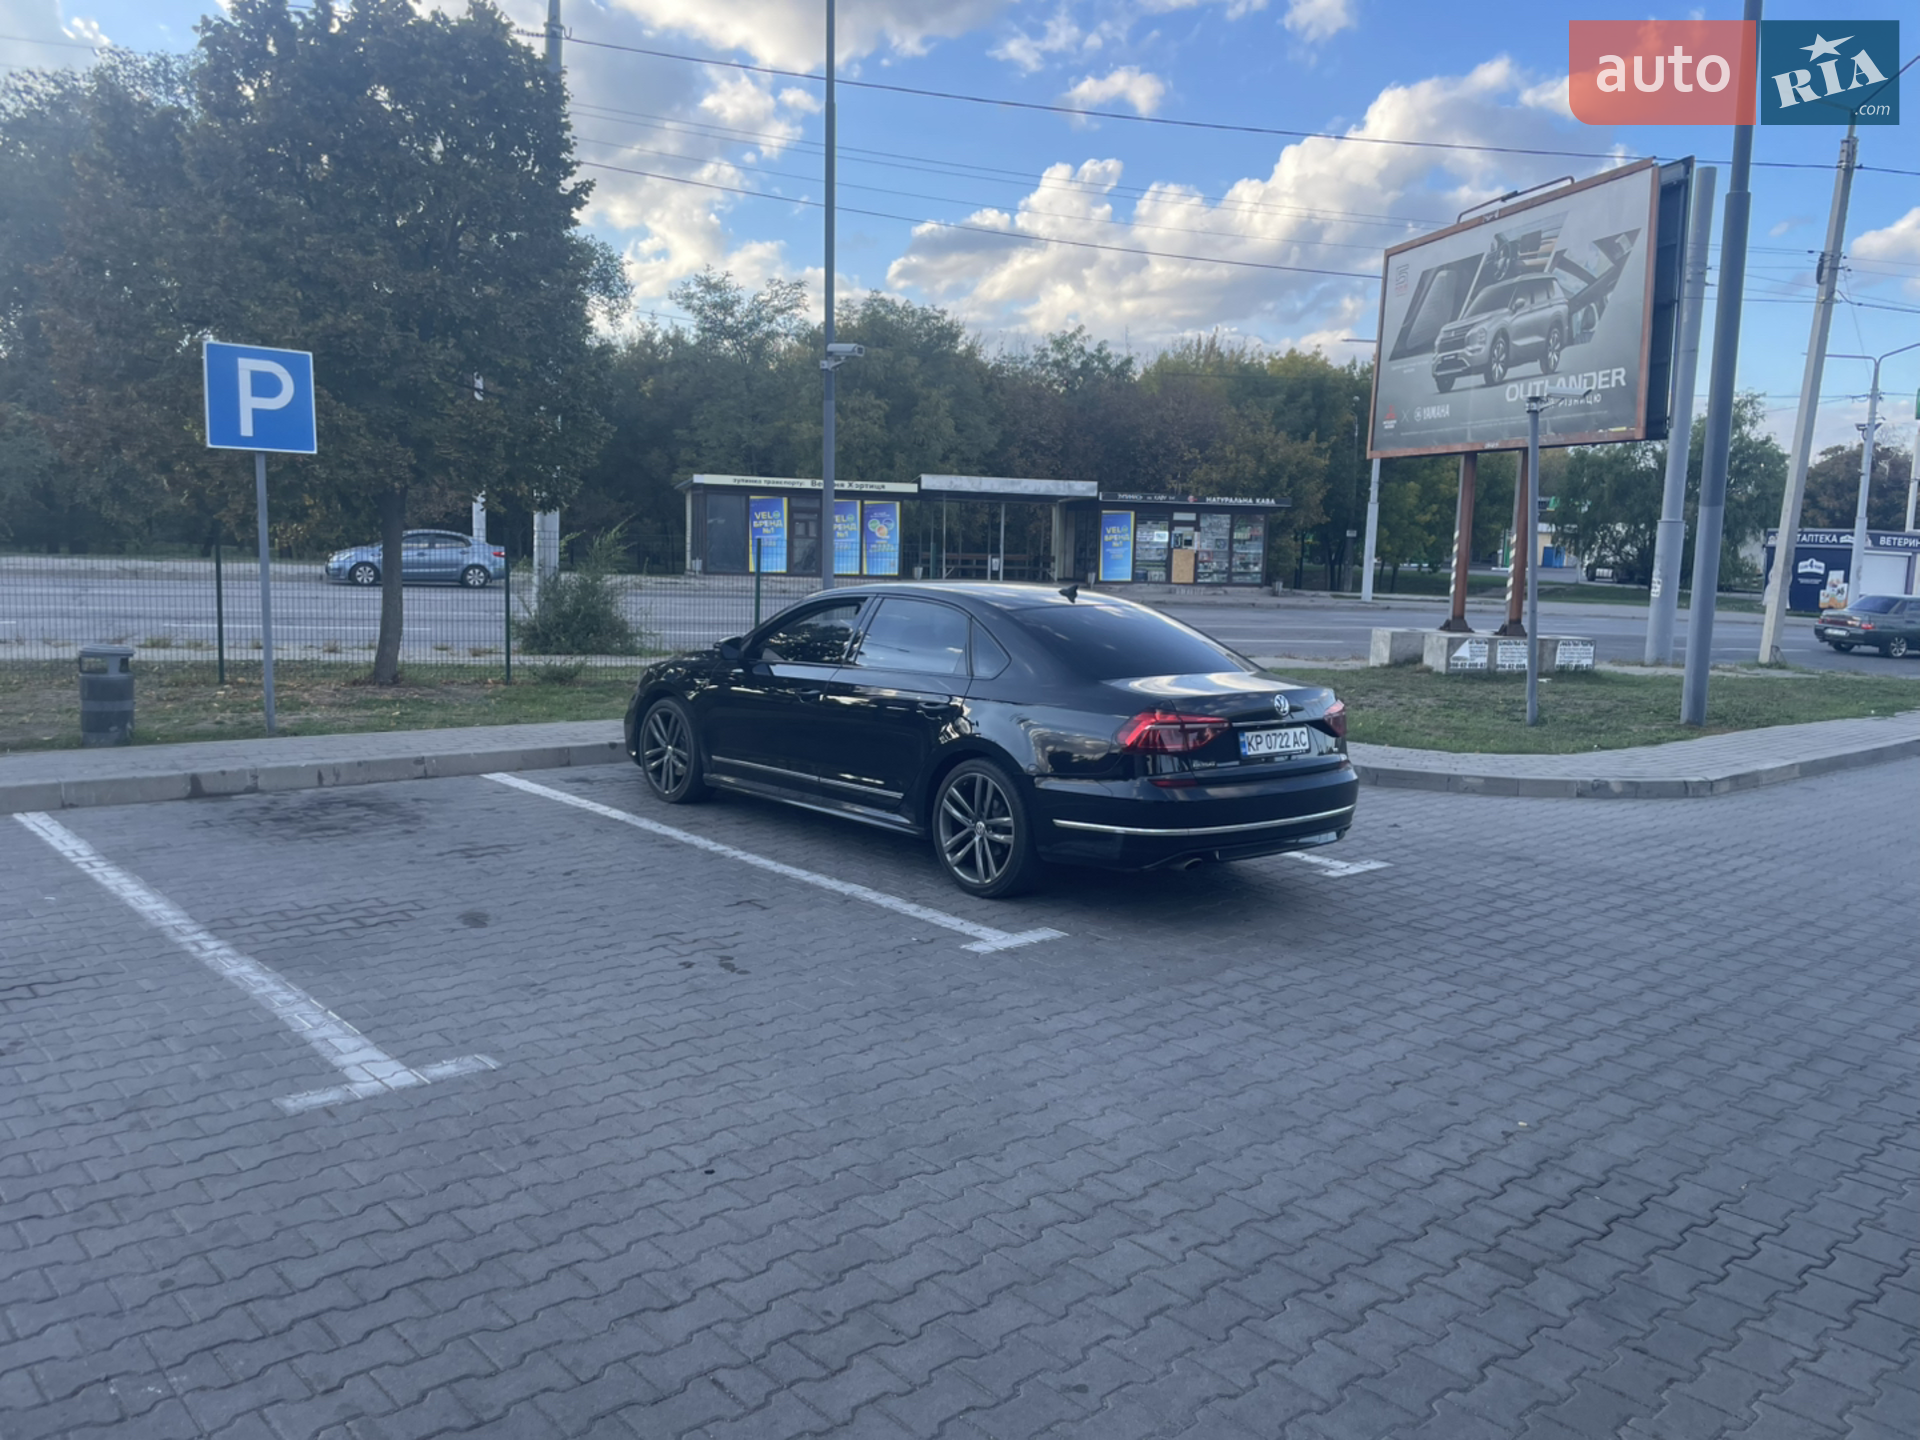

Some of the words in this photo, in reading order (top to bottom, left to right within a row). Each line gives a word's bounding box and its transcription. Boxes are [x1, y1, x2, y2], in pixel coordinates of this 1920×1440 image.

[237, 357, 295, 437] P
[1505, 367, 1627, 402] OUTLANDER
[1205, 496, 1253, 504] НАТУРАЛЬНА
[1246, 734, 1263, 752] KP
[1265, 732, 1291, 750] 0722
[1293, 730, 1307, 748] AC
